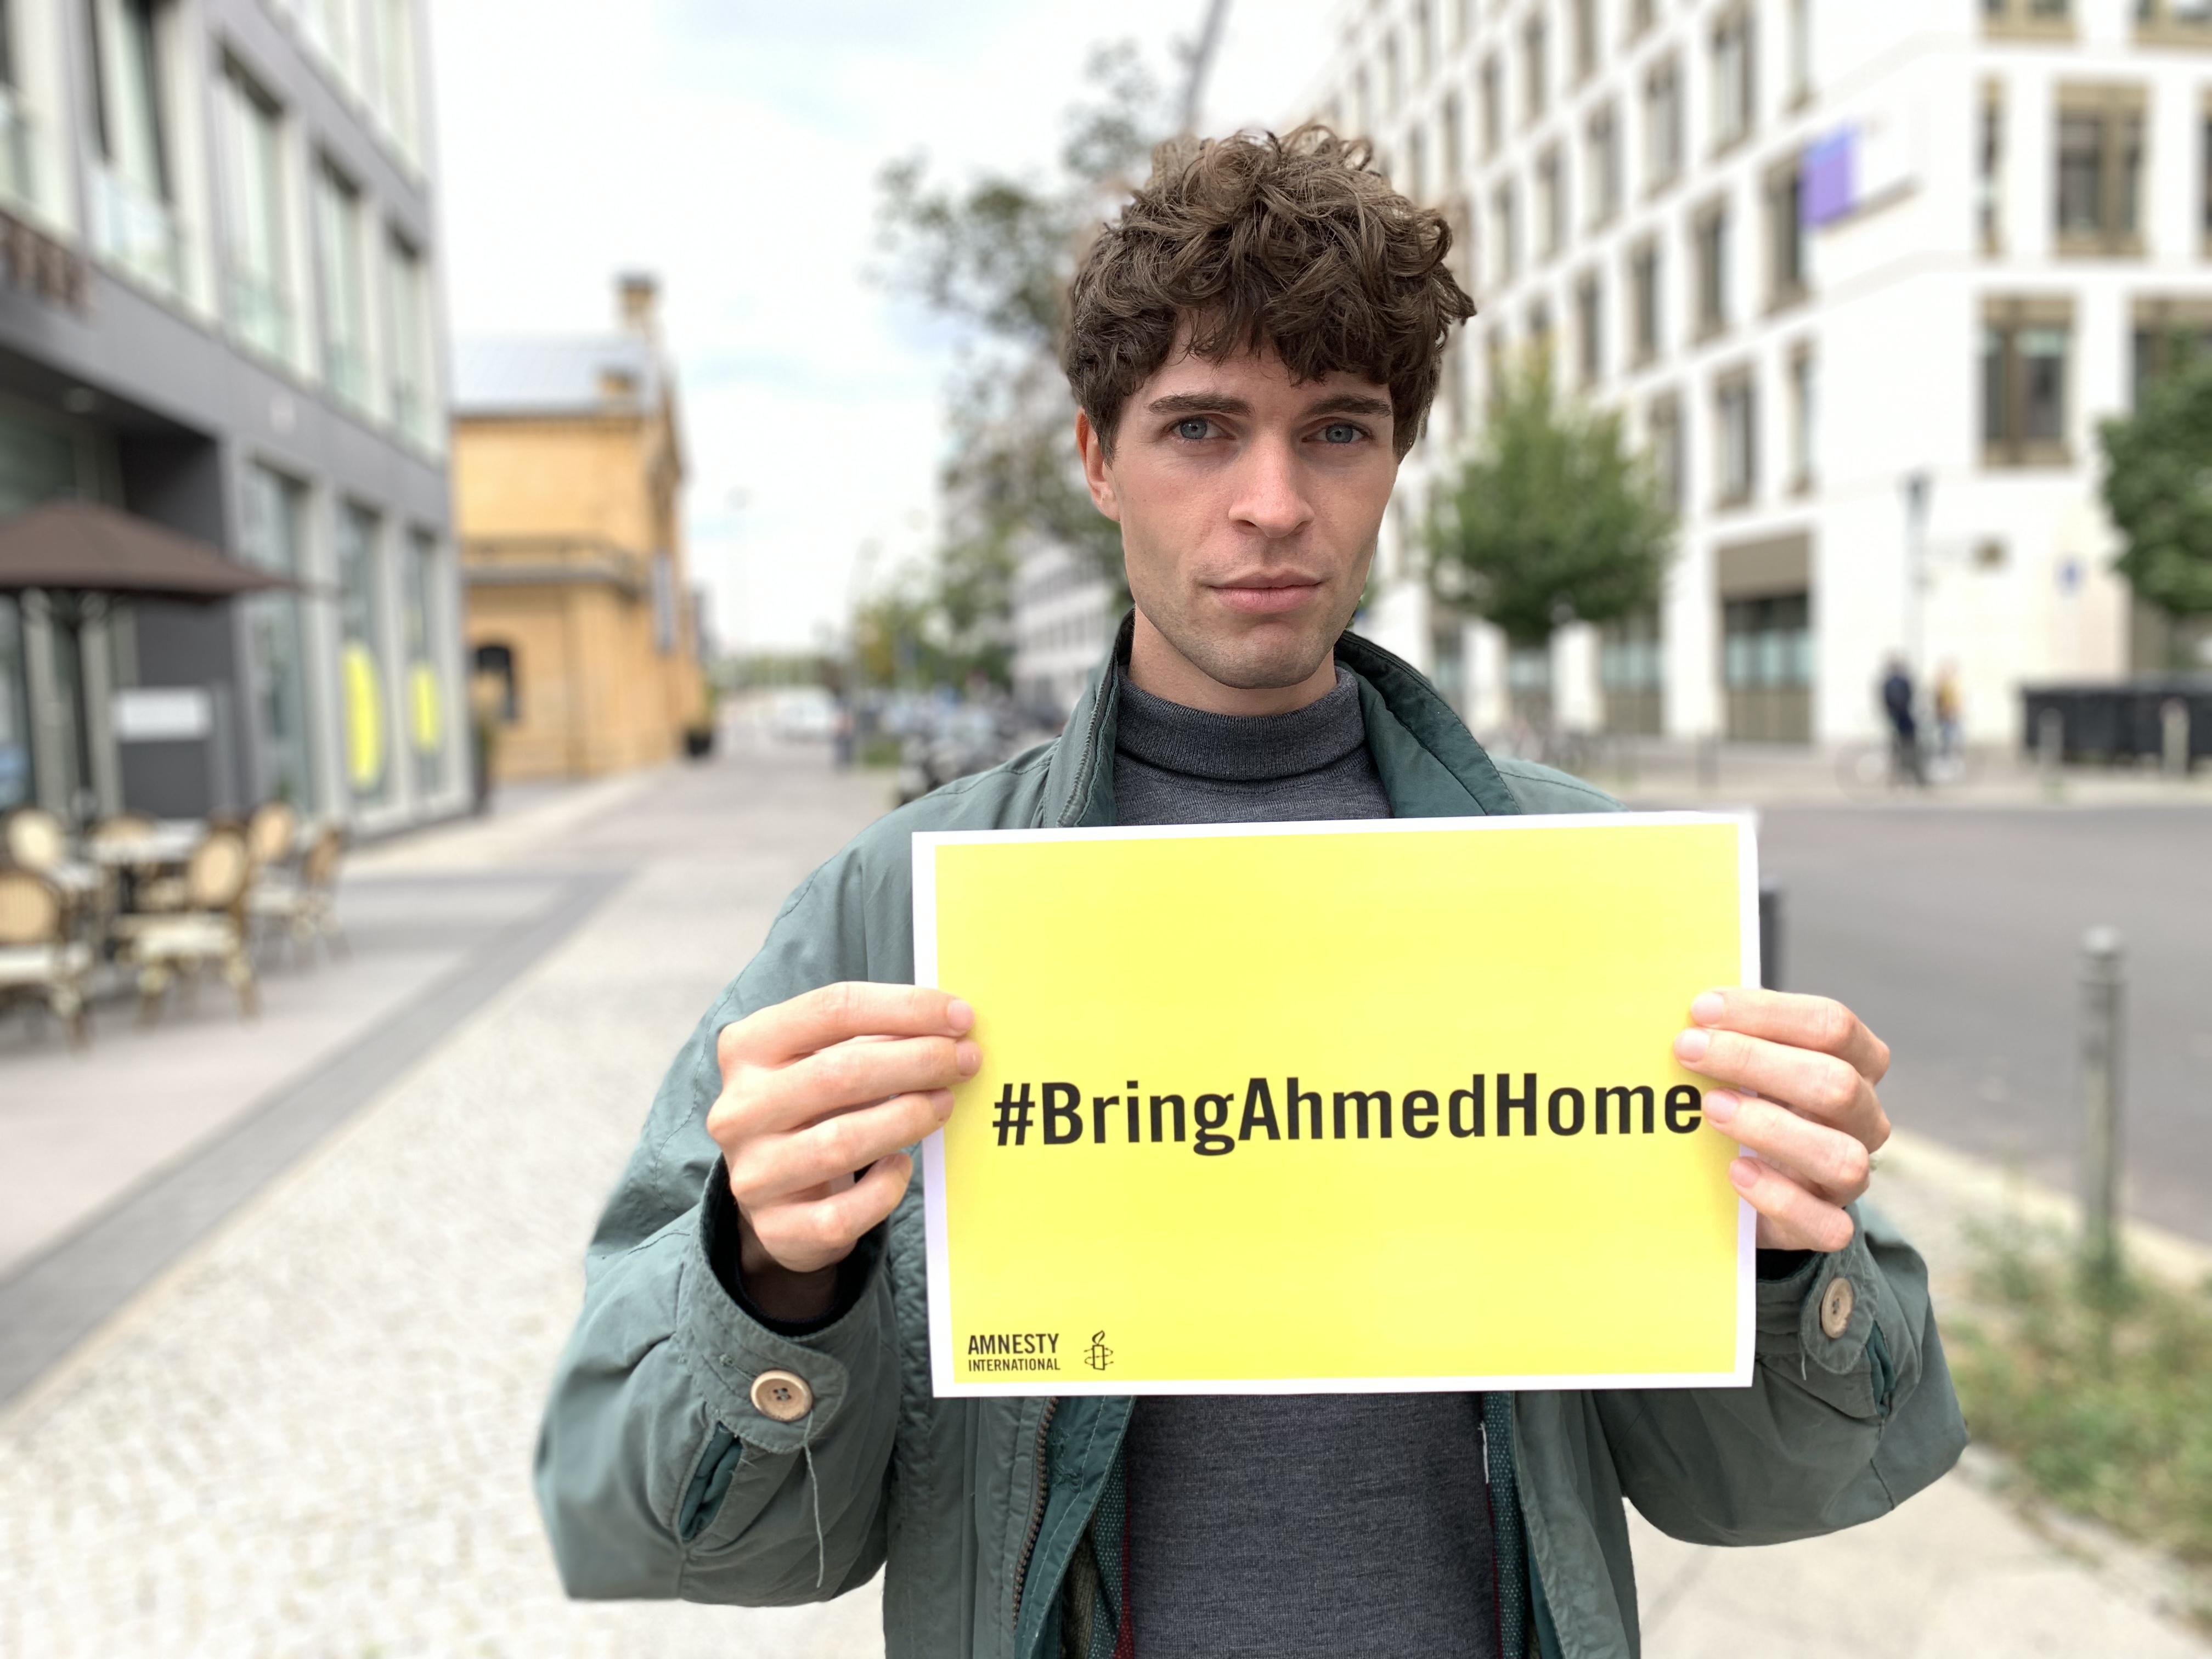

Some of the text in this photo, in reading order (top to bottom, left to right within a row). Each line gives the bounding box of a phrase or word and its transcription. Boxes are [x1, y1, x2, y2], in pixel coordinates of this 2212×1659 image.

[992, 1073, 1702, 1156] #BringAhmedHome
[968, 1333, 1059, 1355] AMNESTY
[968, 1358, 1060, 1372] INTERNATIONAL
